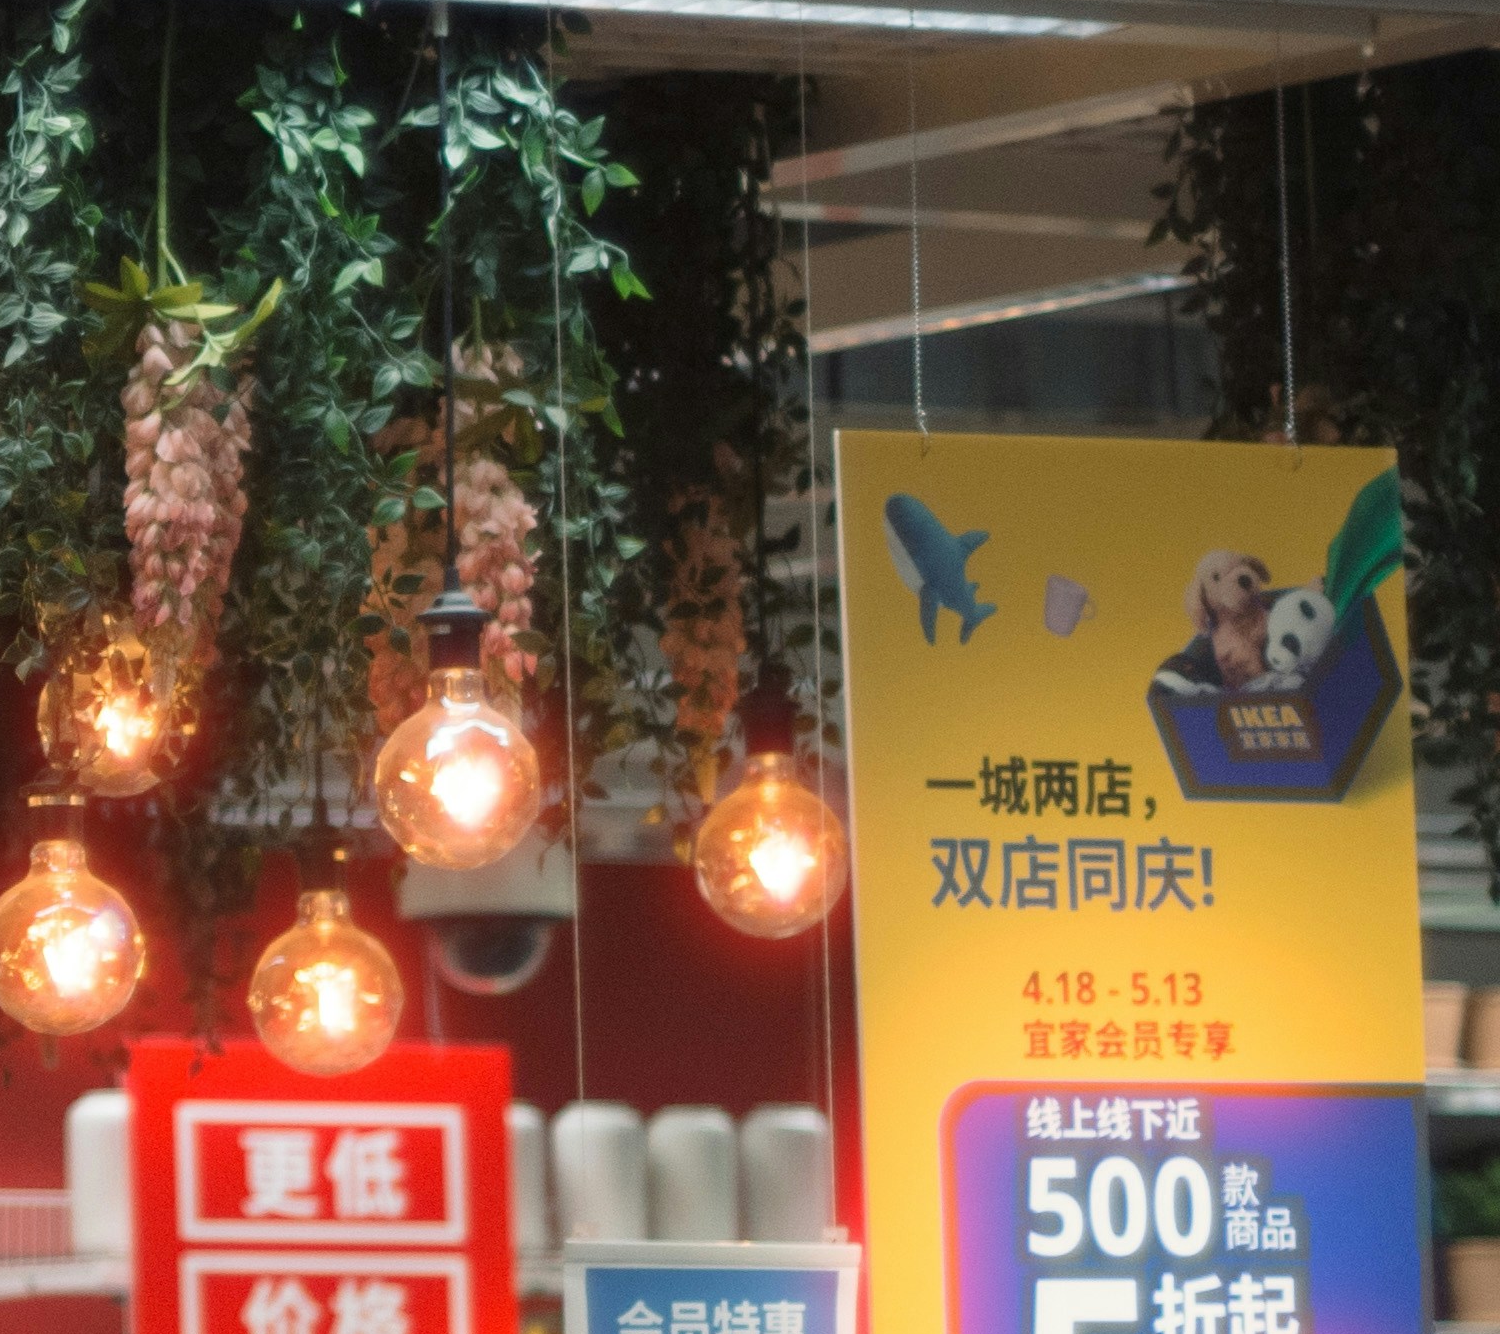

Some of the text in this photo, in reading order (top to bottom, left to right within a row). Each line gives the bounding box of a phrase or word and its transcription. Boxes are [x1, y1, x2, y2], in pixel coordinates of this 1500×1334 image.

[1229, 705, 1304, 728] IKEA
[1022, 970, 1096, 1005] 4.18
[1132, 972, 1204, 1005] 5.13
[1023, 1019, 1236, 1062] 宜家会员专享
[1026, 1098, 1202, 1141] 线上线下近
[237, 1128, 410, 1219] 更低
[1222, 1163, 1260, 1207] 款
[1027, 1156, 1212, 1258] 500
[1225, 1207, 1297, 1252] 商品
